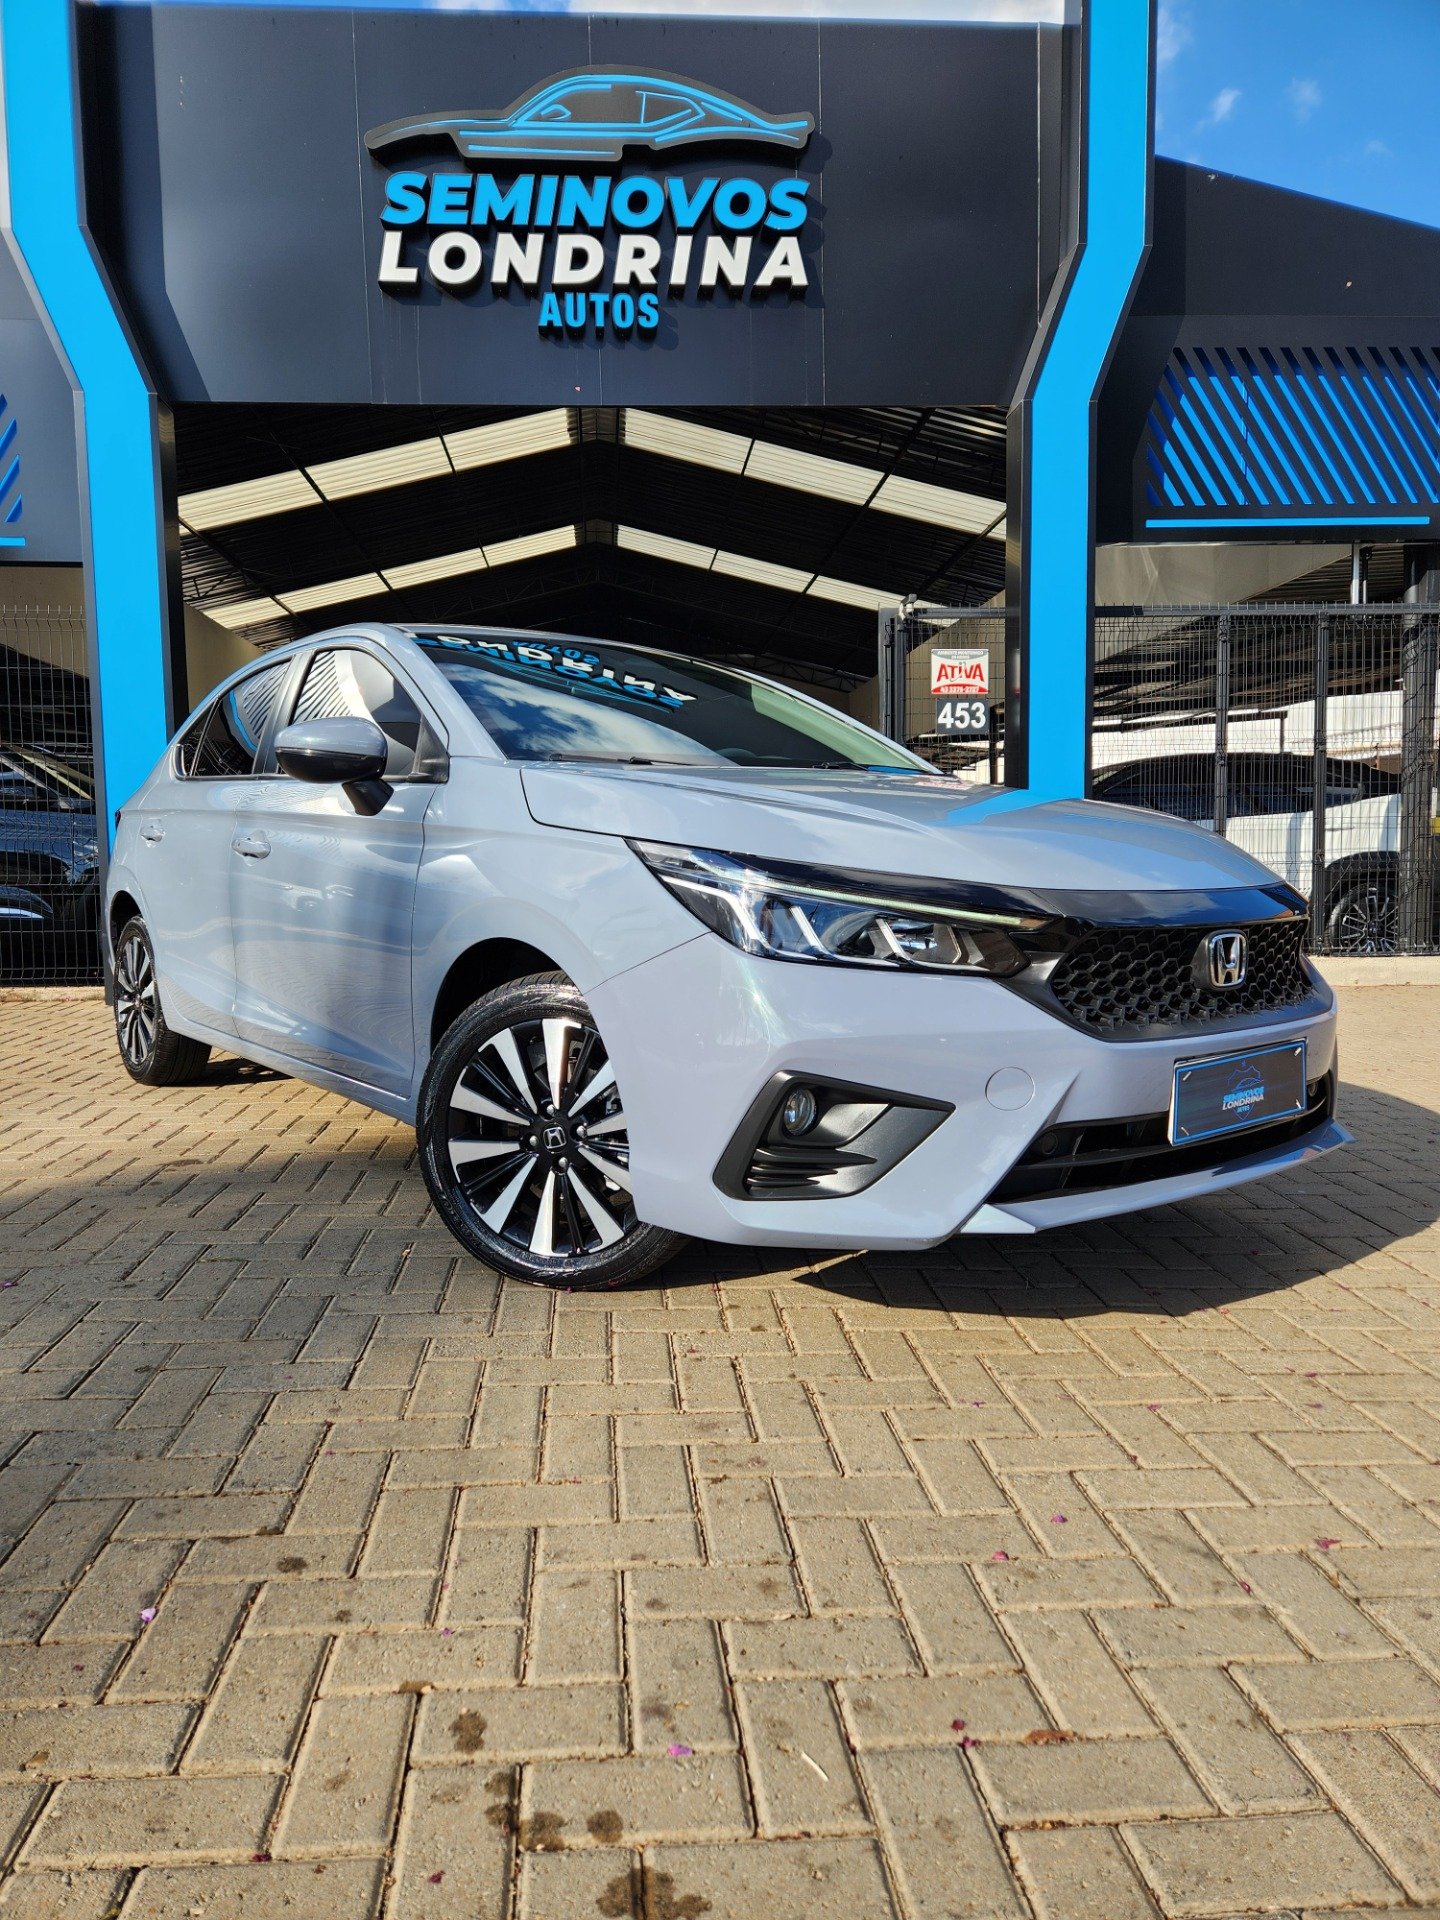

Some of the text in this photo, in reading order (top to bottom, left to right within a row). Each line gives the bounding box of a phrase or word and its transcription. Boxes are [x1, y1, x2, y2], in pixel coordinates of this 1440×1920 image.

[381, 170, 811, 231] SEMINOVOS
[378, 230, 809, 287] LONDRINA
[538, 291, 660, 330] AUTOS
[937, 701, 987, 729] 453
[1222, 1094, 1265, 1111] LONDRINA
[1223, 1086, 1265, 1102] SEMINOVOS
